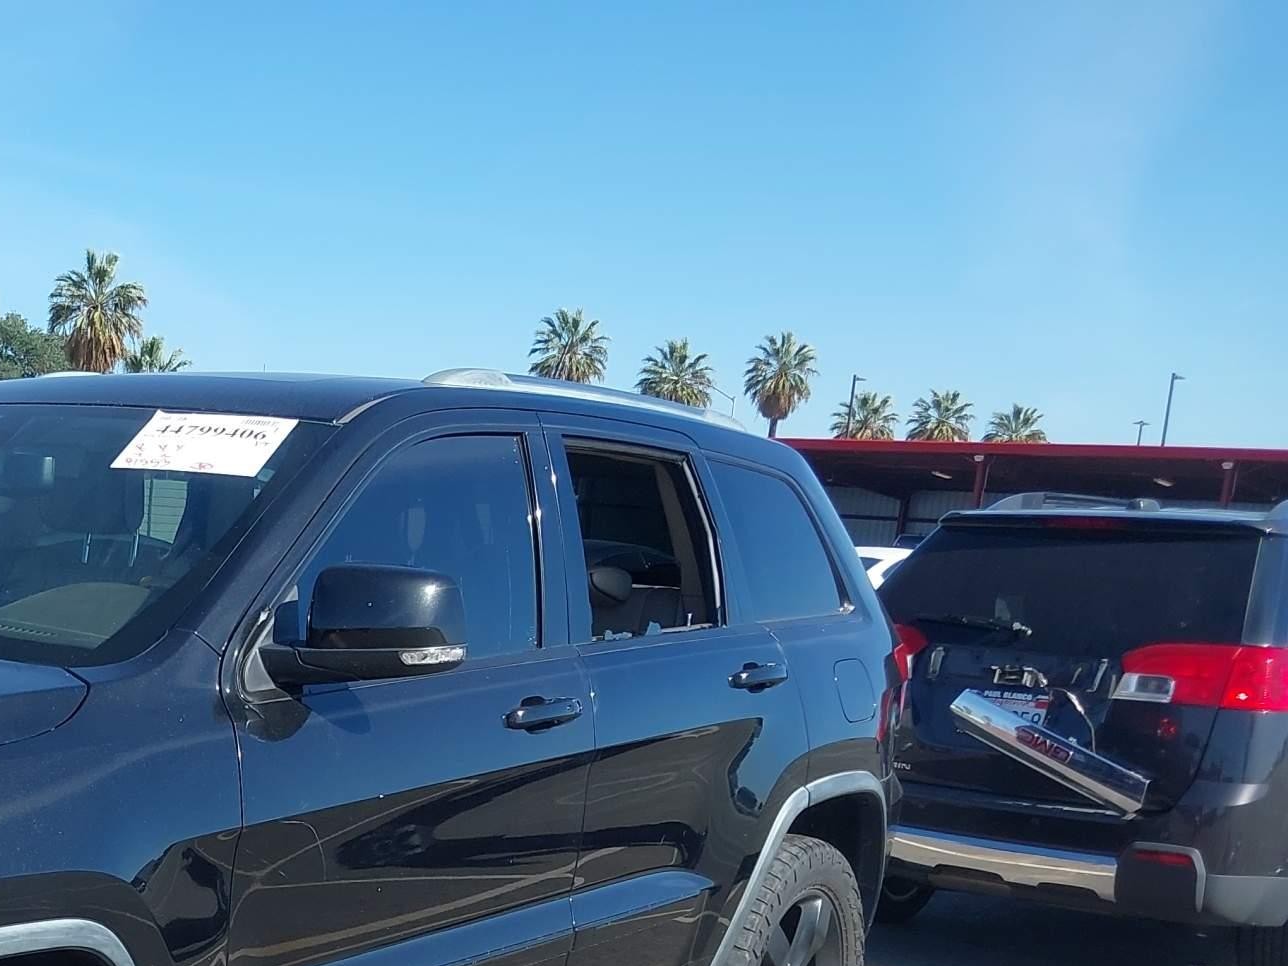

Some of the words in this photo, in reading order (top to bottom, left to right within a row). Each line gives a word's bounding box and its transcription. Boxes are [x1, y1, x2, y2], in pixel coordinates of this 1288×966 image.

[155, 423, 268, 441] 44799406
[983, 689, 1001, 698] PAUL
[1002, 691, 1033, 701] BLANCO
[1015, 729, 1070, 762] GMC
